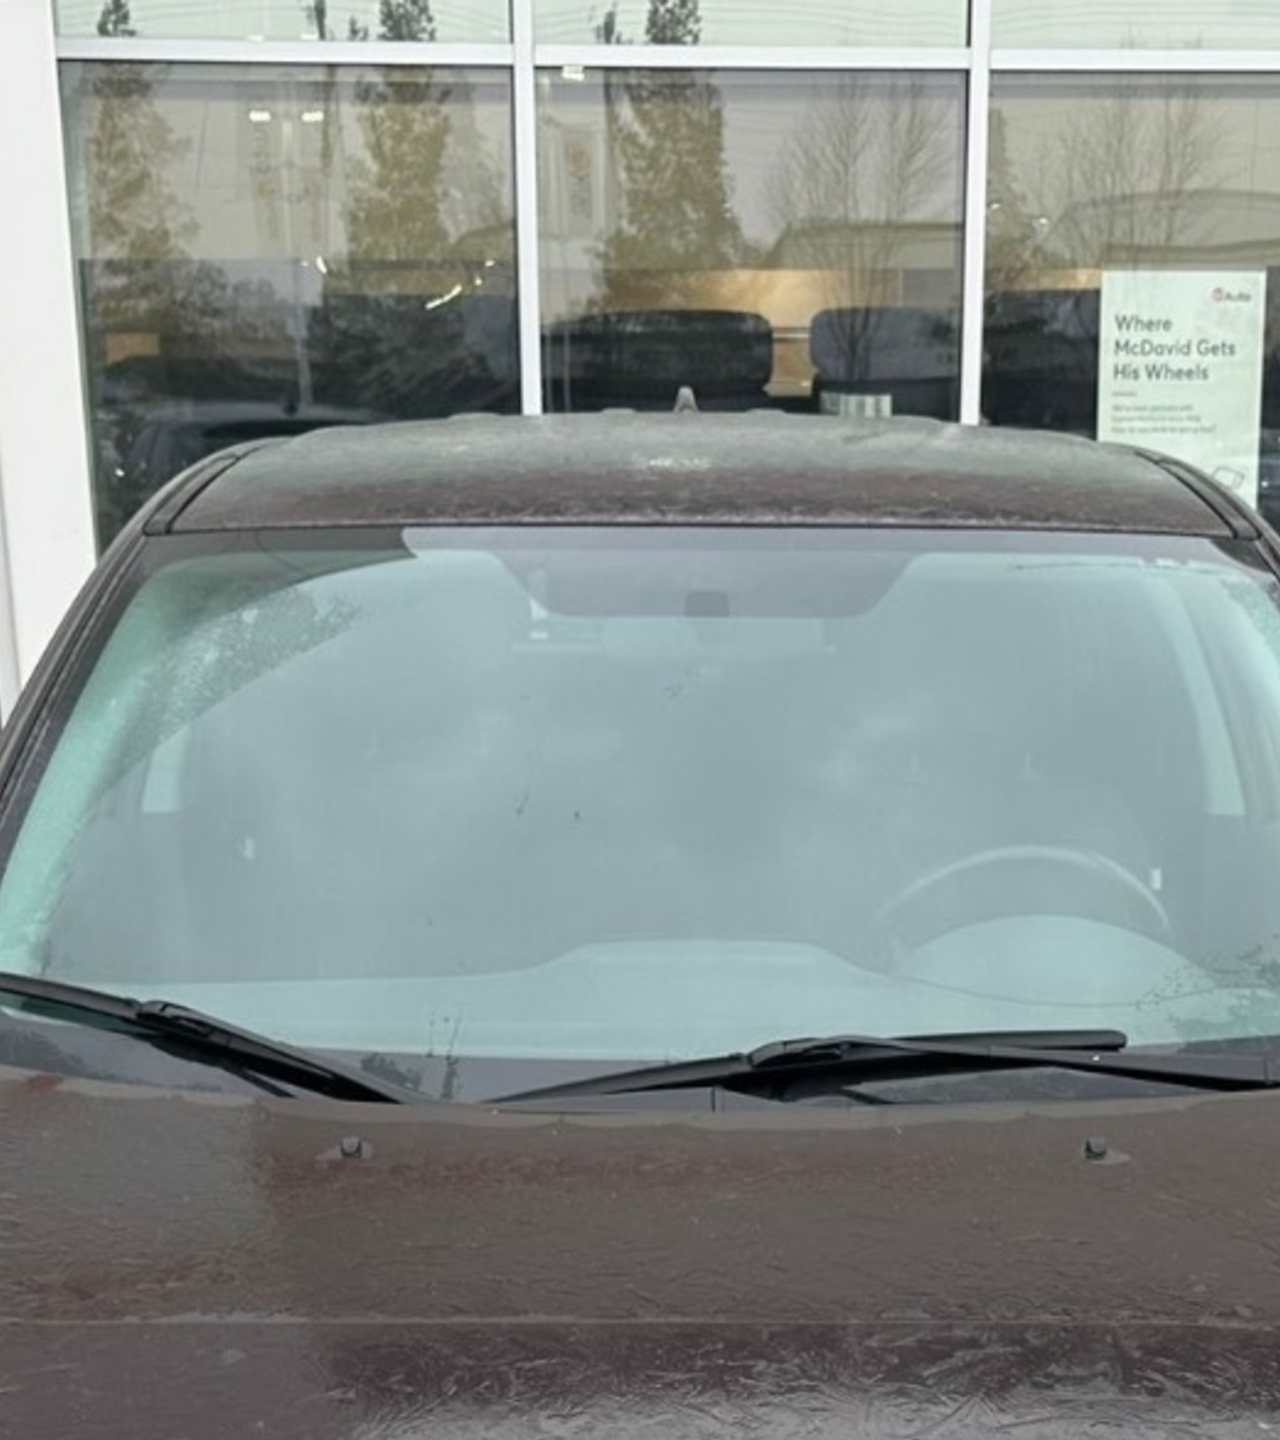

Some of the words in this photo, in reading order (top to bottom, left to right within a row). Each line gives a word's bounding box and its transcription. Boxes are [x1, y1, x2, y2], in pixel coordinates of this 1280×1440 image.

[1114, 314, 1173, 332] Where
[1113, 338, 1192, 356] McDavid
[1196, 338, 1236, 356] Gets
[1113, 362, 1139, 381] His
[1144, 362, 1209, 381] Wheels
